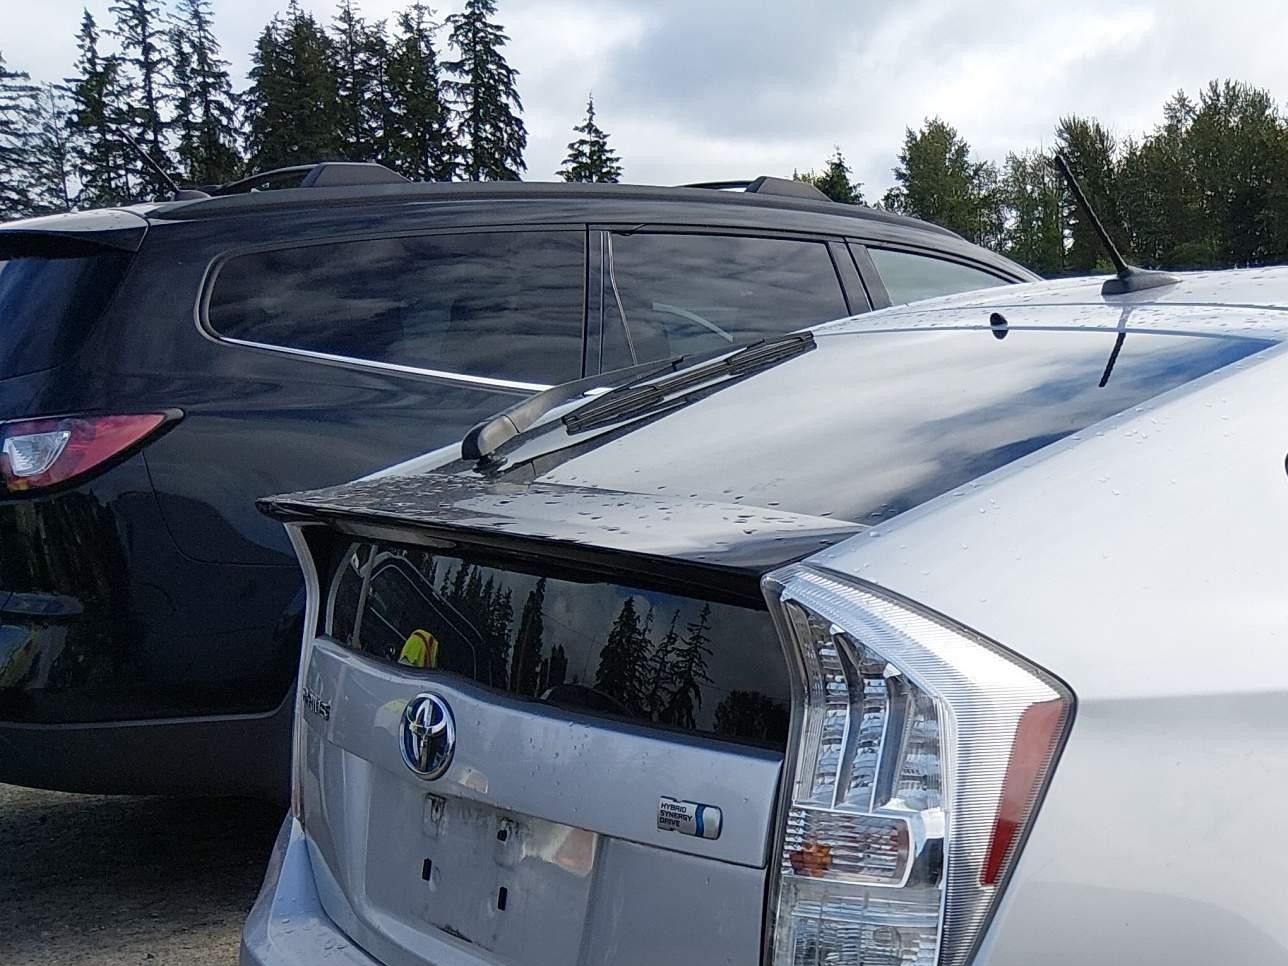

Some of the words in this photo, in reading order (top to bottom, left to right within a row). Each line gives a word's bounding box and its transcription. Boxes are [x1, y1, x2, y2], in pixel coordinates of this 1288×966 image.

[660, 802, 687, 814] HYBRID
[660, 809, 693, 822] SYNERGY
[659, 817, 680, 828] DRIVE
